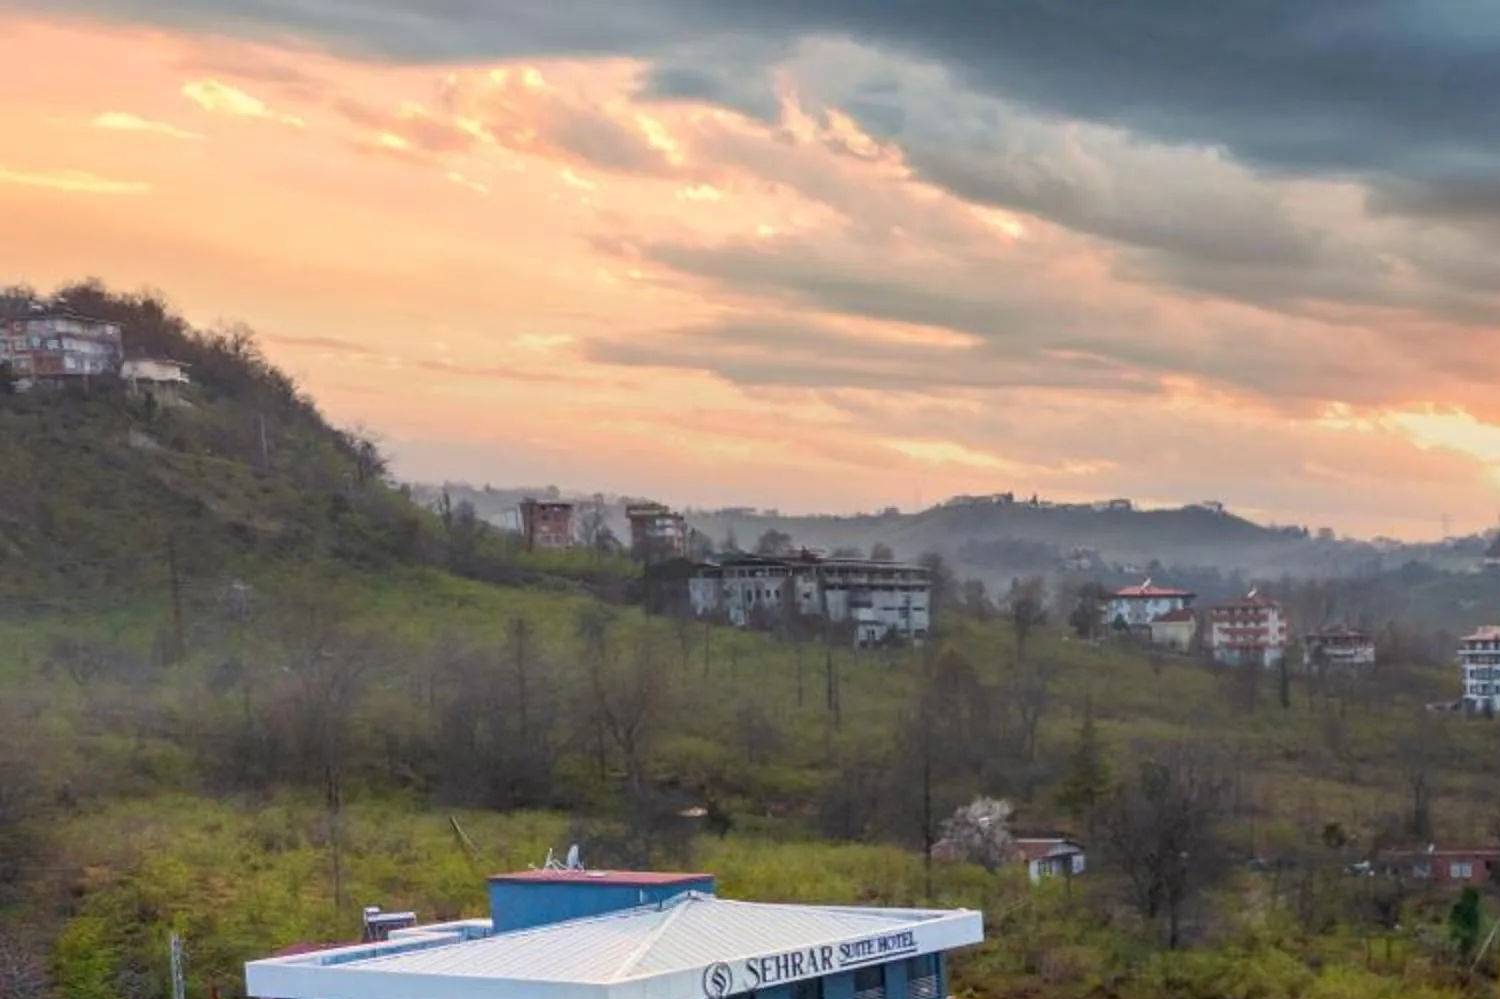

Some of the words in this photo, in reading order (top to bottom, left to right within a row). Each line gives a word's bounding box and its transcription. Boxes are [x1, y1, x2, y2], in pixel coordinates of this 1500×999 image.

[745, 945, 833, 988] SEHRAR
[839, 938, 874, 962] SUITE
[877, 930, 917, 952] HOTEL
